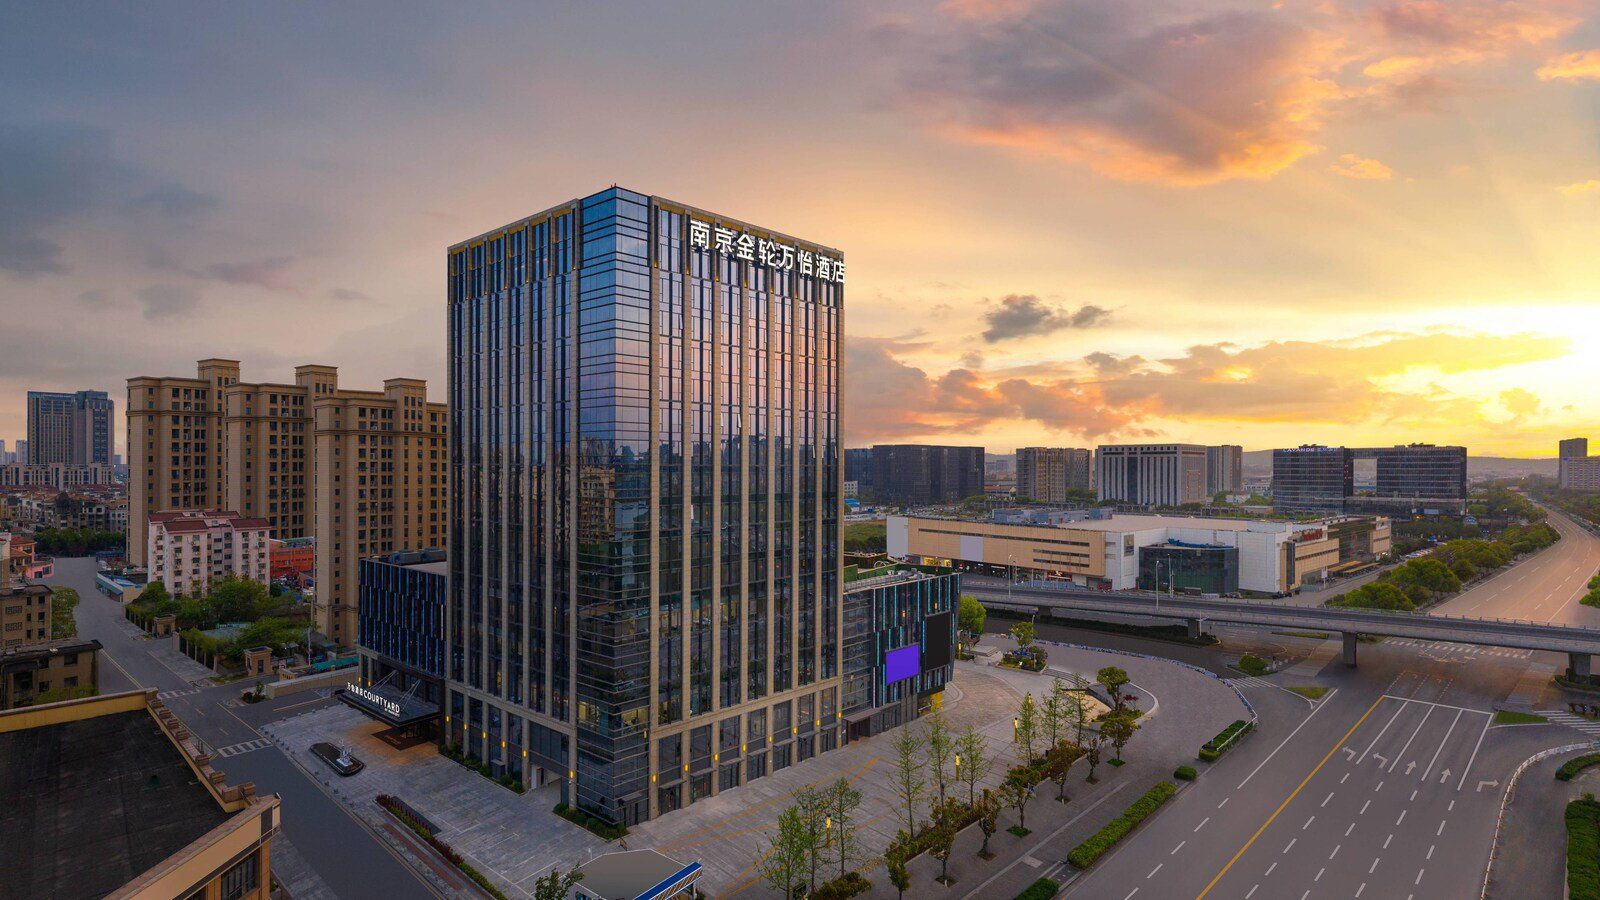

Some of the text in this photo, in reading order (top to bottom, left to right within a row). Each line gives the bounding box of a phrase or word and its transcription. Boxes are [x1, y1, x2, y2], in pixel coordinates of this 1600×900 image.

[690, 219, 846, 283] 南京金轮万怡酒店
[363, 690, 400, 713] COURTYARD
